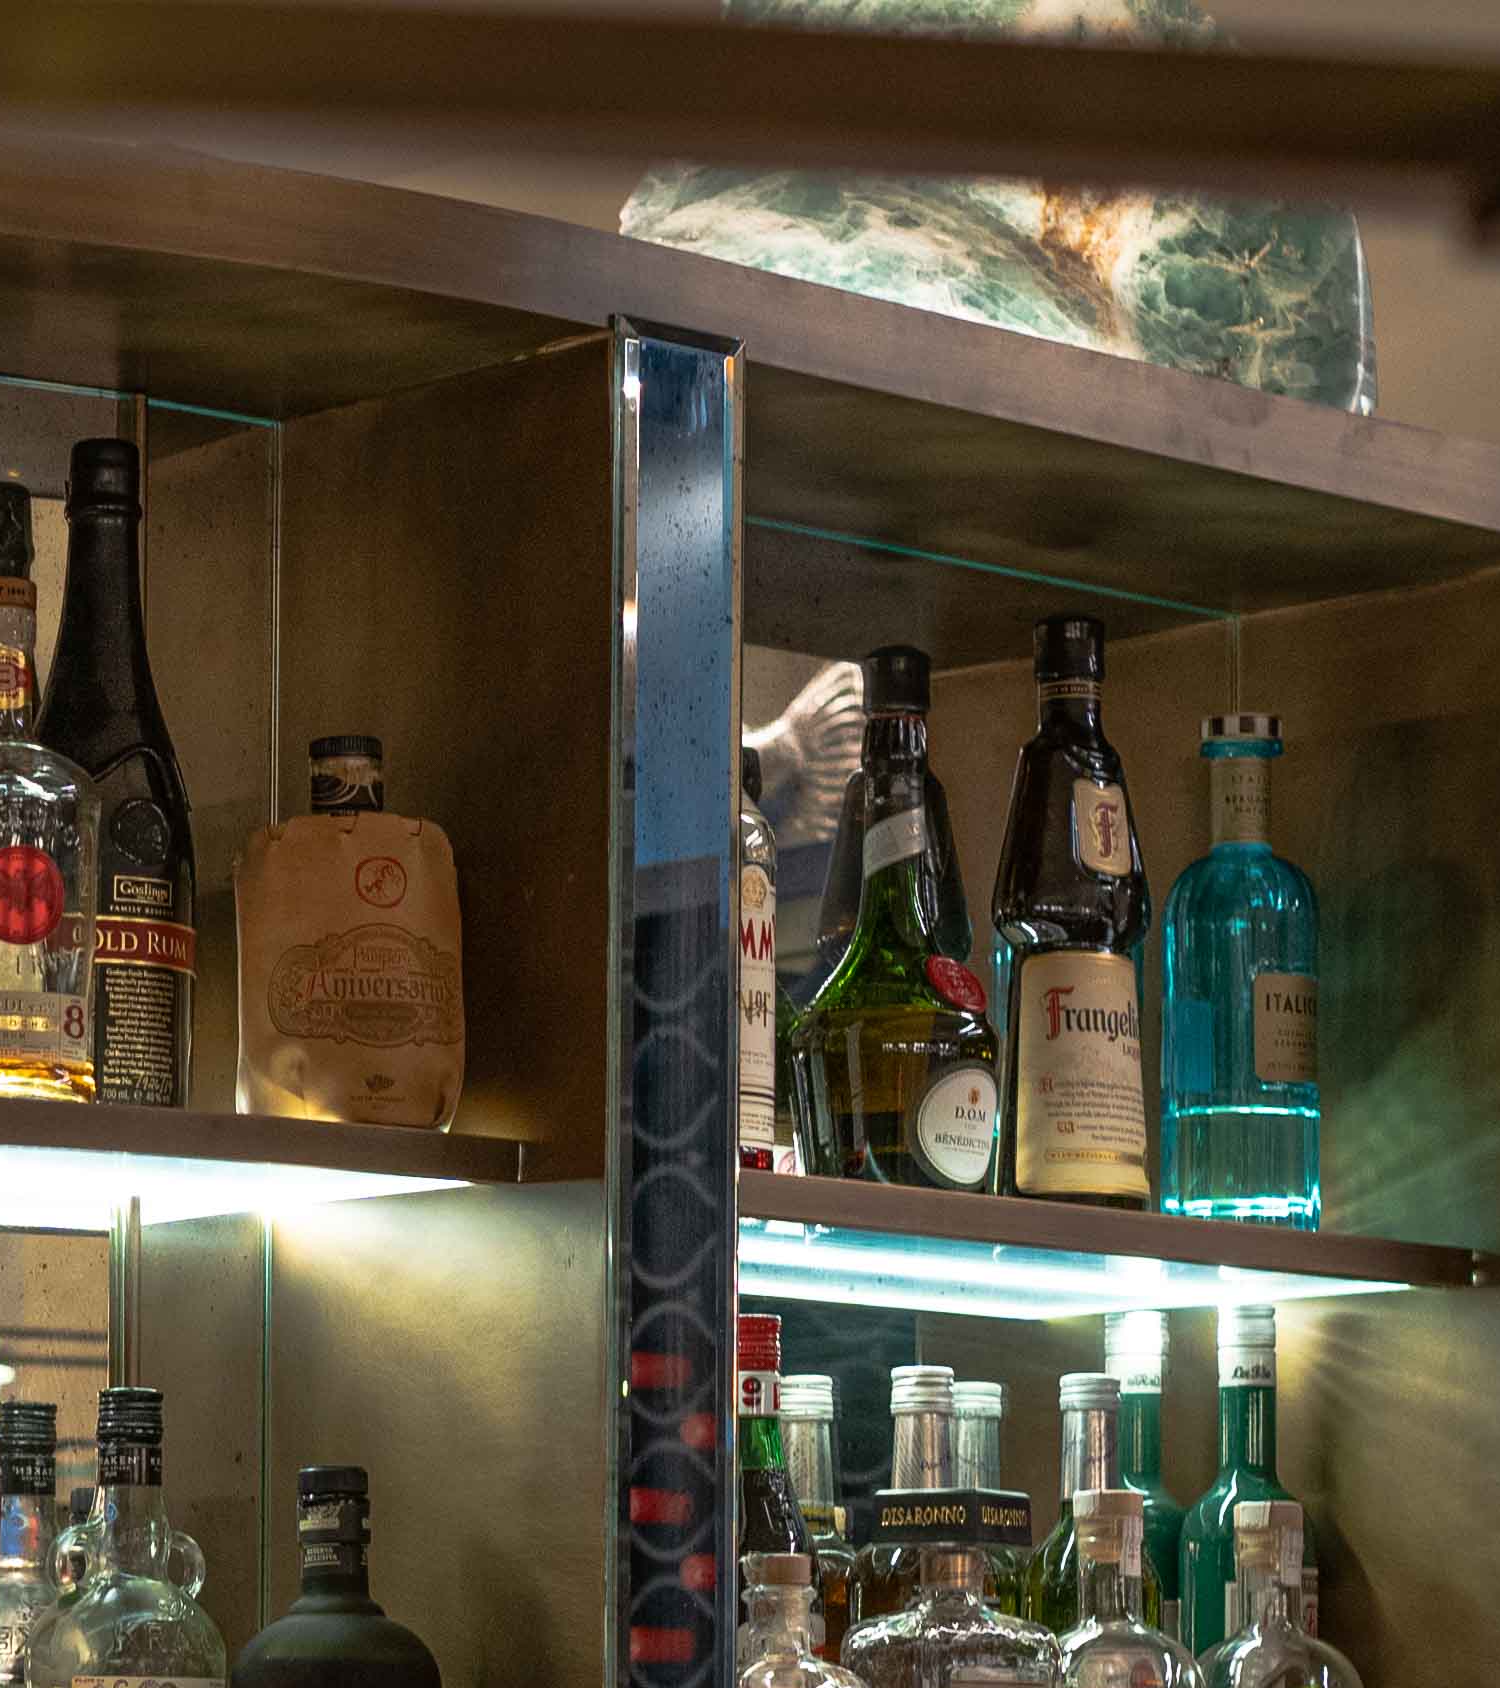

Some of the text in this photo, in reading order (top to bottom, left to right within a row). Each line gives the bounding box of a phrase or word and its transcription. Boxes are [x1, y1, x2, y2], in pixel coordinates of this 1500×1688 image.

[147, 931, 188, 961] RUM
[63, 1004, 85, 1040] 8
[881, 1506, 967, 1527] DISARONNO
